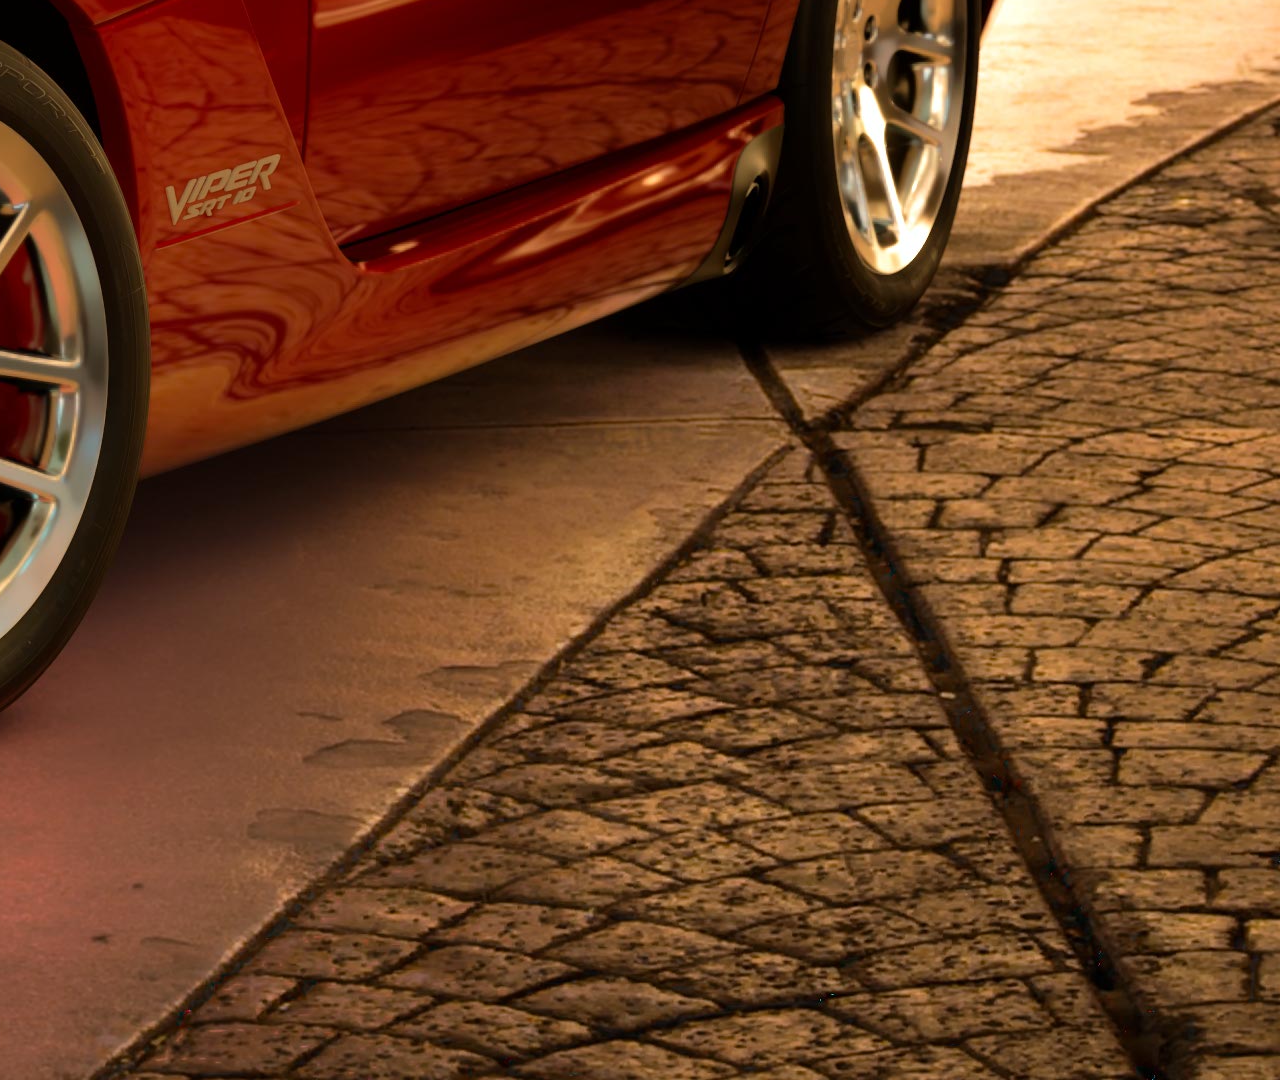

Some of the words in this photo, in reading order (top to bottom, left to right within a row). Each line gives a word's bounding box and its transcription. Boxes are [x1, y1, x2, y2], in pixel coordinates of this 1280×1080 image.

[165, 154, 281, 226] VIPER
[182, 193, 232, 221] SRT
[232, 186, 257, 206] 10
